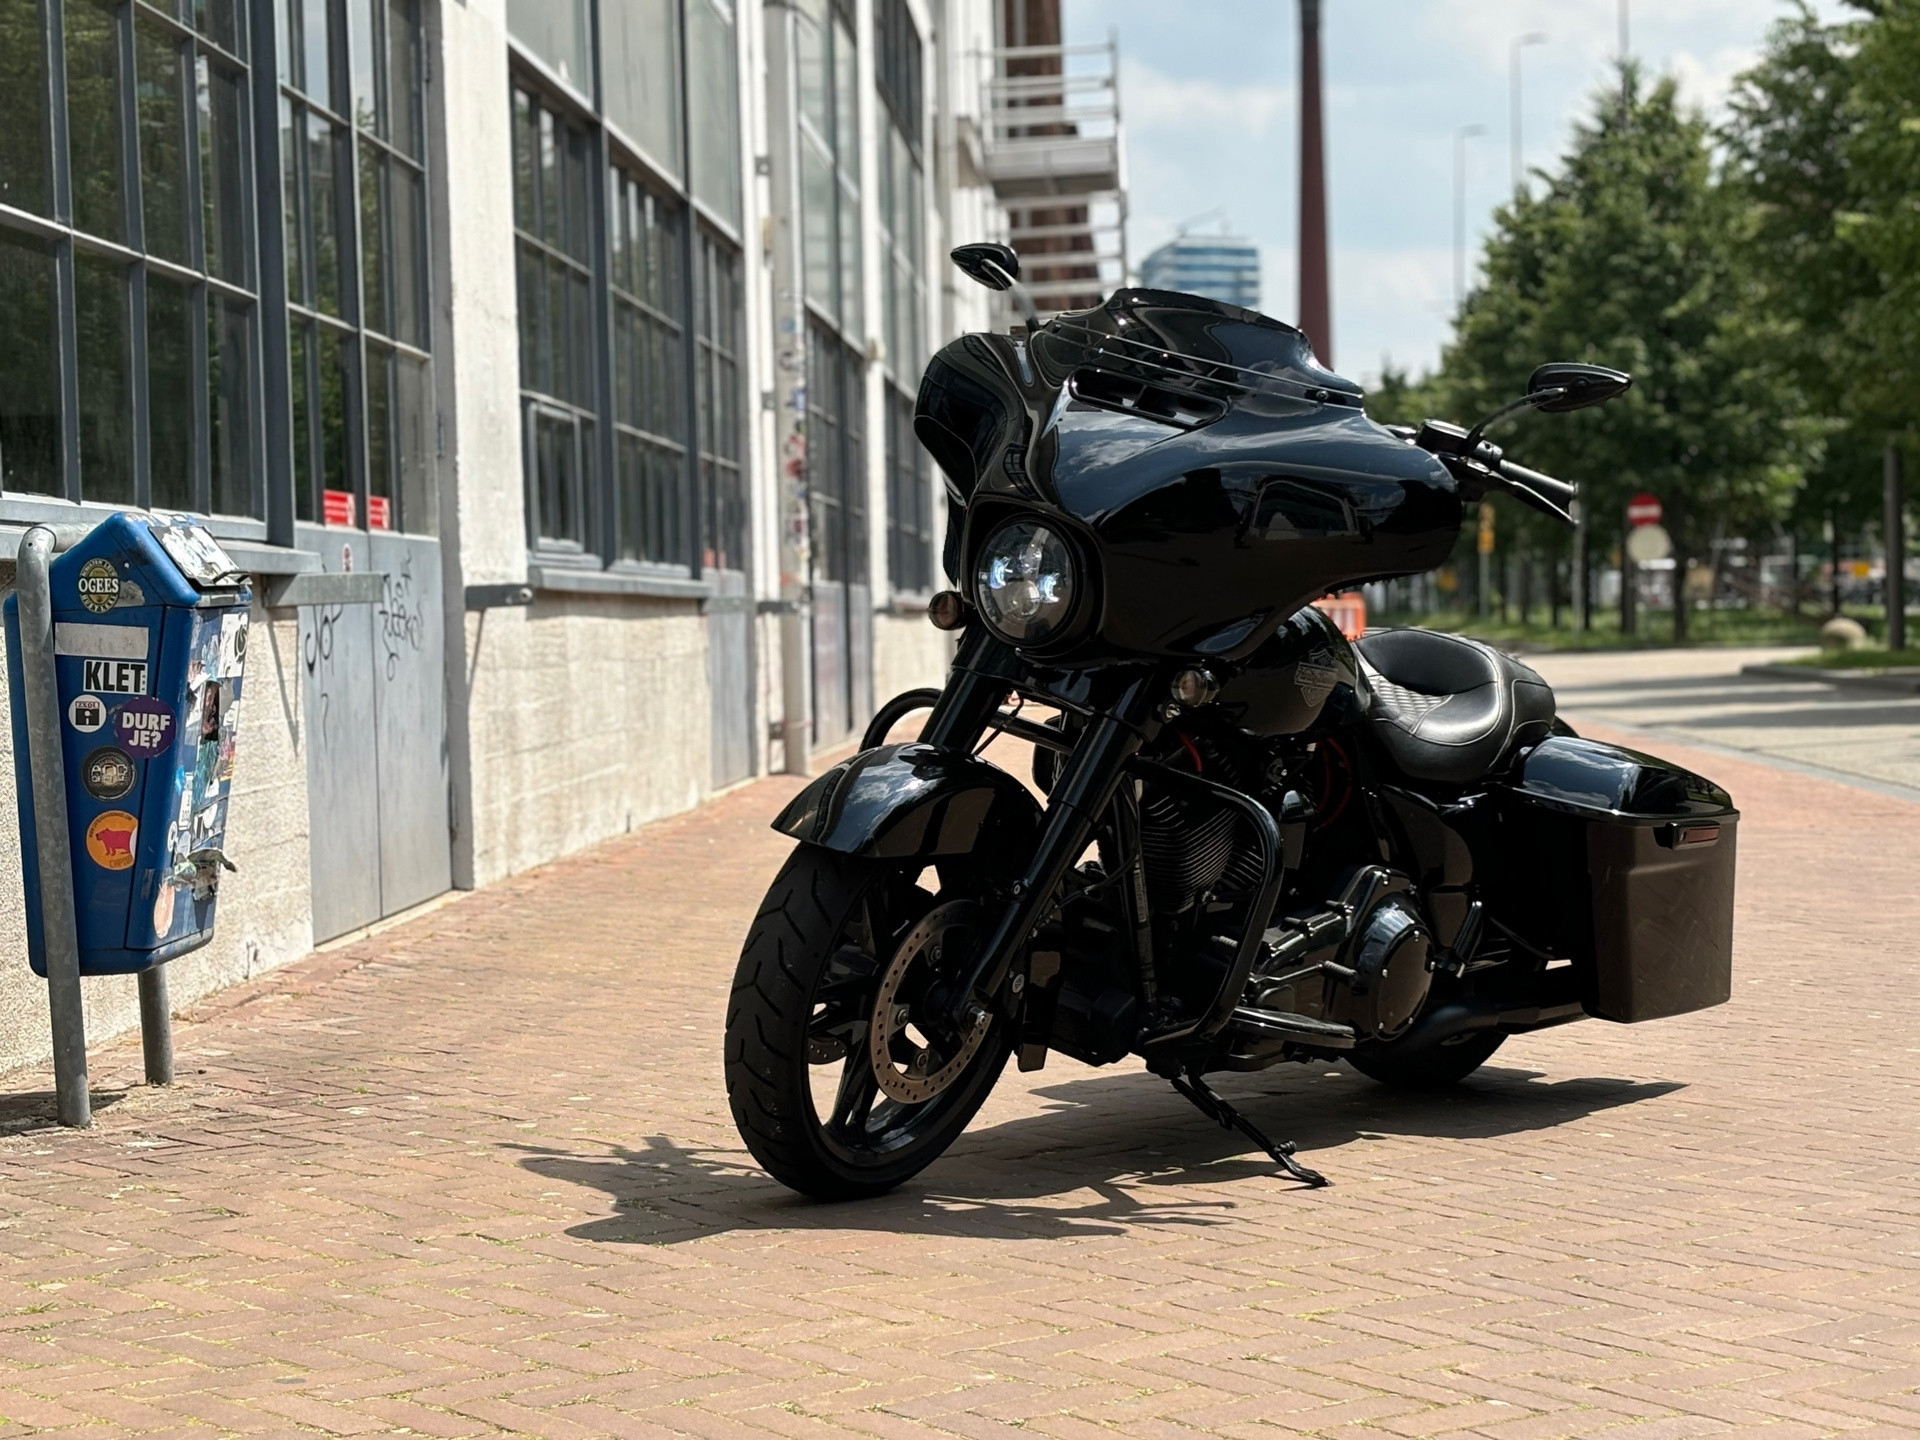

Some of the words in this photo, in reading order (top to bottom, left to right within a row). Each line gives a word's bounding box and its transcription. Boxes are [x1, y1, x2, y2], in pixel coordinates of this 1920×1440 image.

[78, 578, 119, 593] OGEES
[85, 661, 146, 693] KLET
[122, 711, 171, 731] DURF
[128, 729, 162, 749] JE?
